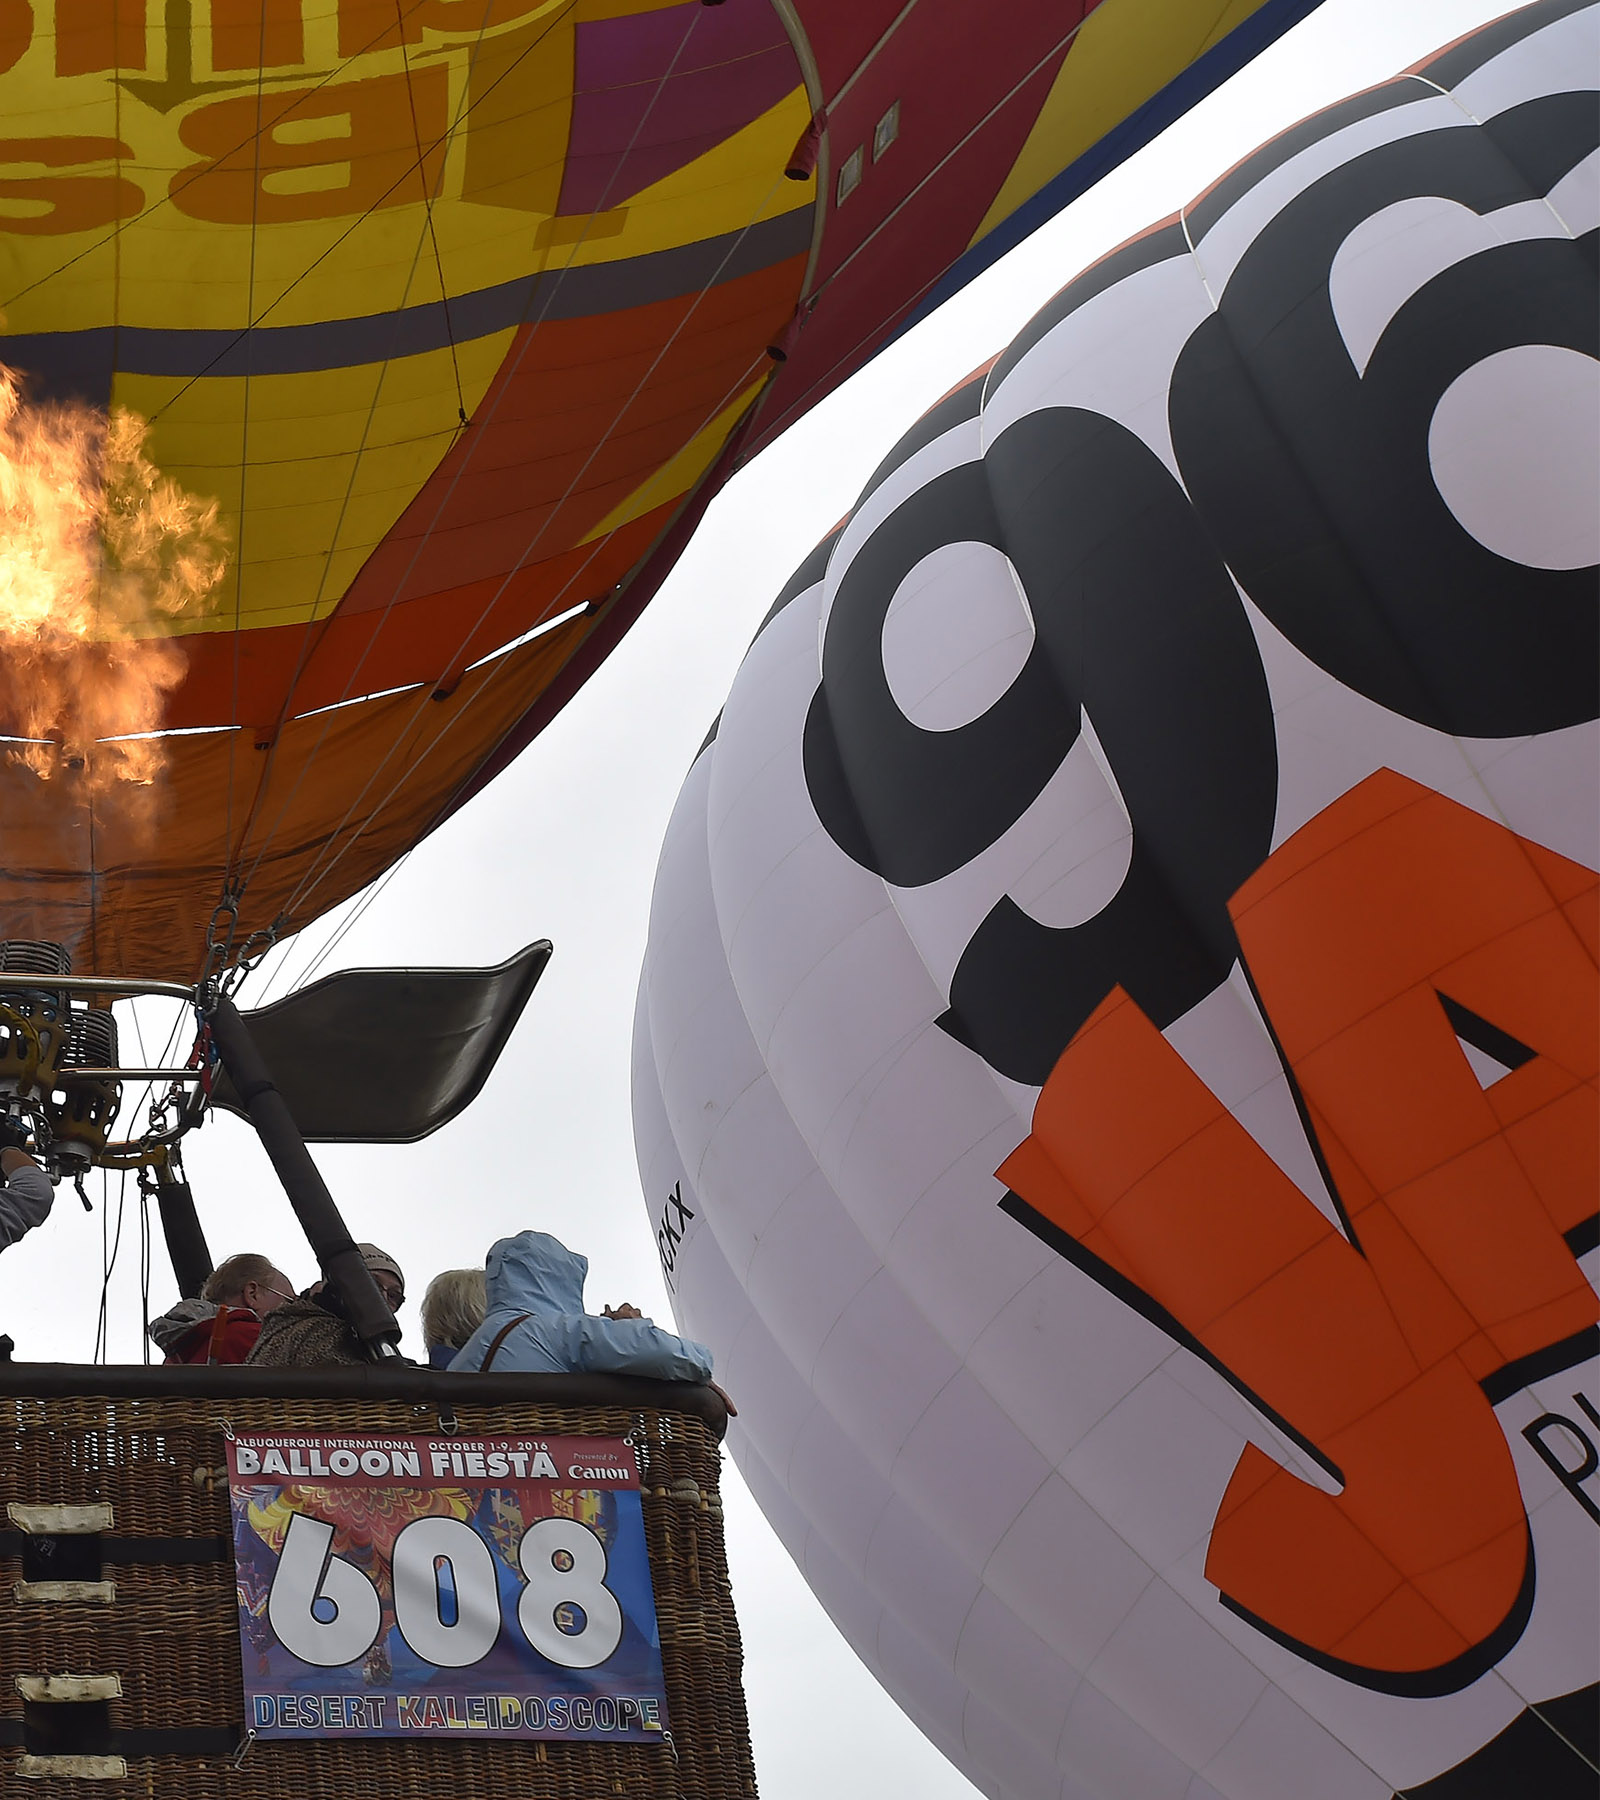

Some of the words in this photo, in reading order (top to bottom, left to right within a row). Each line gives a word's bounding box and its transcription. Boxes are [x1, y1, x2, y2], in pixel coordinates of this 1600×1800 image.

[235, 1438, 320, 1448] ALBUQUERQUE
[324, 1439, 417, 1450] INTERNATIONAL
[428, 1442, 485, 1451] OCTOBER
[490, 1442, 513, 1452] 1-9,
[517, 1441, 549, 1451] 2016
[236, 1447, 421, 1477] BALLOON
[430, 1452, 560, 1479] FIESTA
[573, 1453, 607, 1461] Presented
[568, 1465, 630, 1480] Canon
[267, 1511, 623, 1669] 608
[252, 1695, 386, 1729] DESERT
[397, 1696, 662, 1731] KALEIDOSCOPE
